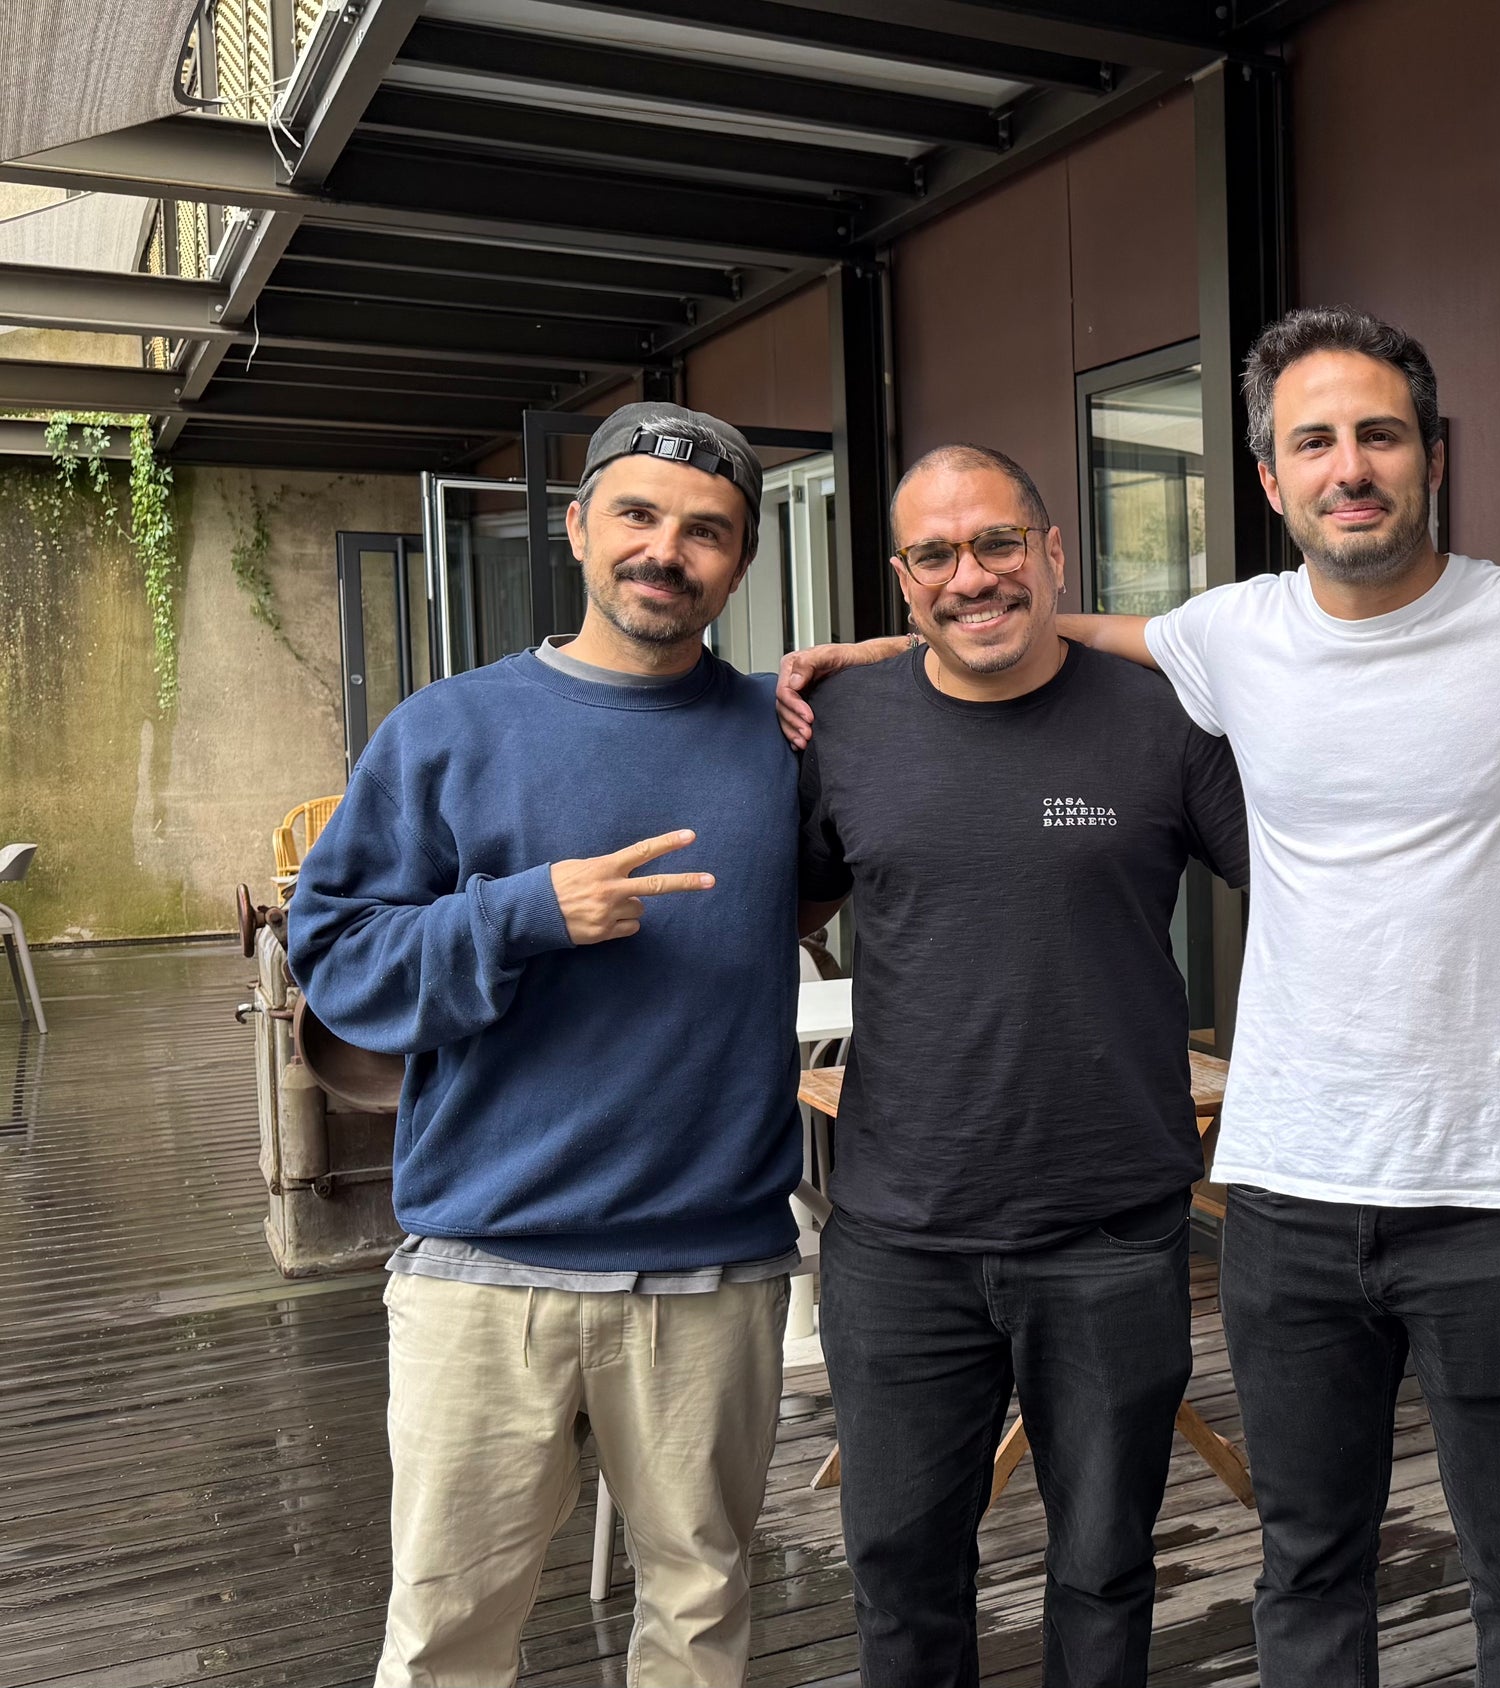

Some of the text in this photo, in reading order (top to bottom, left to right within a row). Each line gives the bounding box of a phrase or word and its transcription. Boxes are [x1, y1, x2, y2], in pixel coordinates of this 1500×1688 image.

[1043, 797, 1085, 806] CASA
[1043, 807, 1116, 816] ALMEIDA
[1043, 817, 1117, 827] BARRETO
